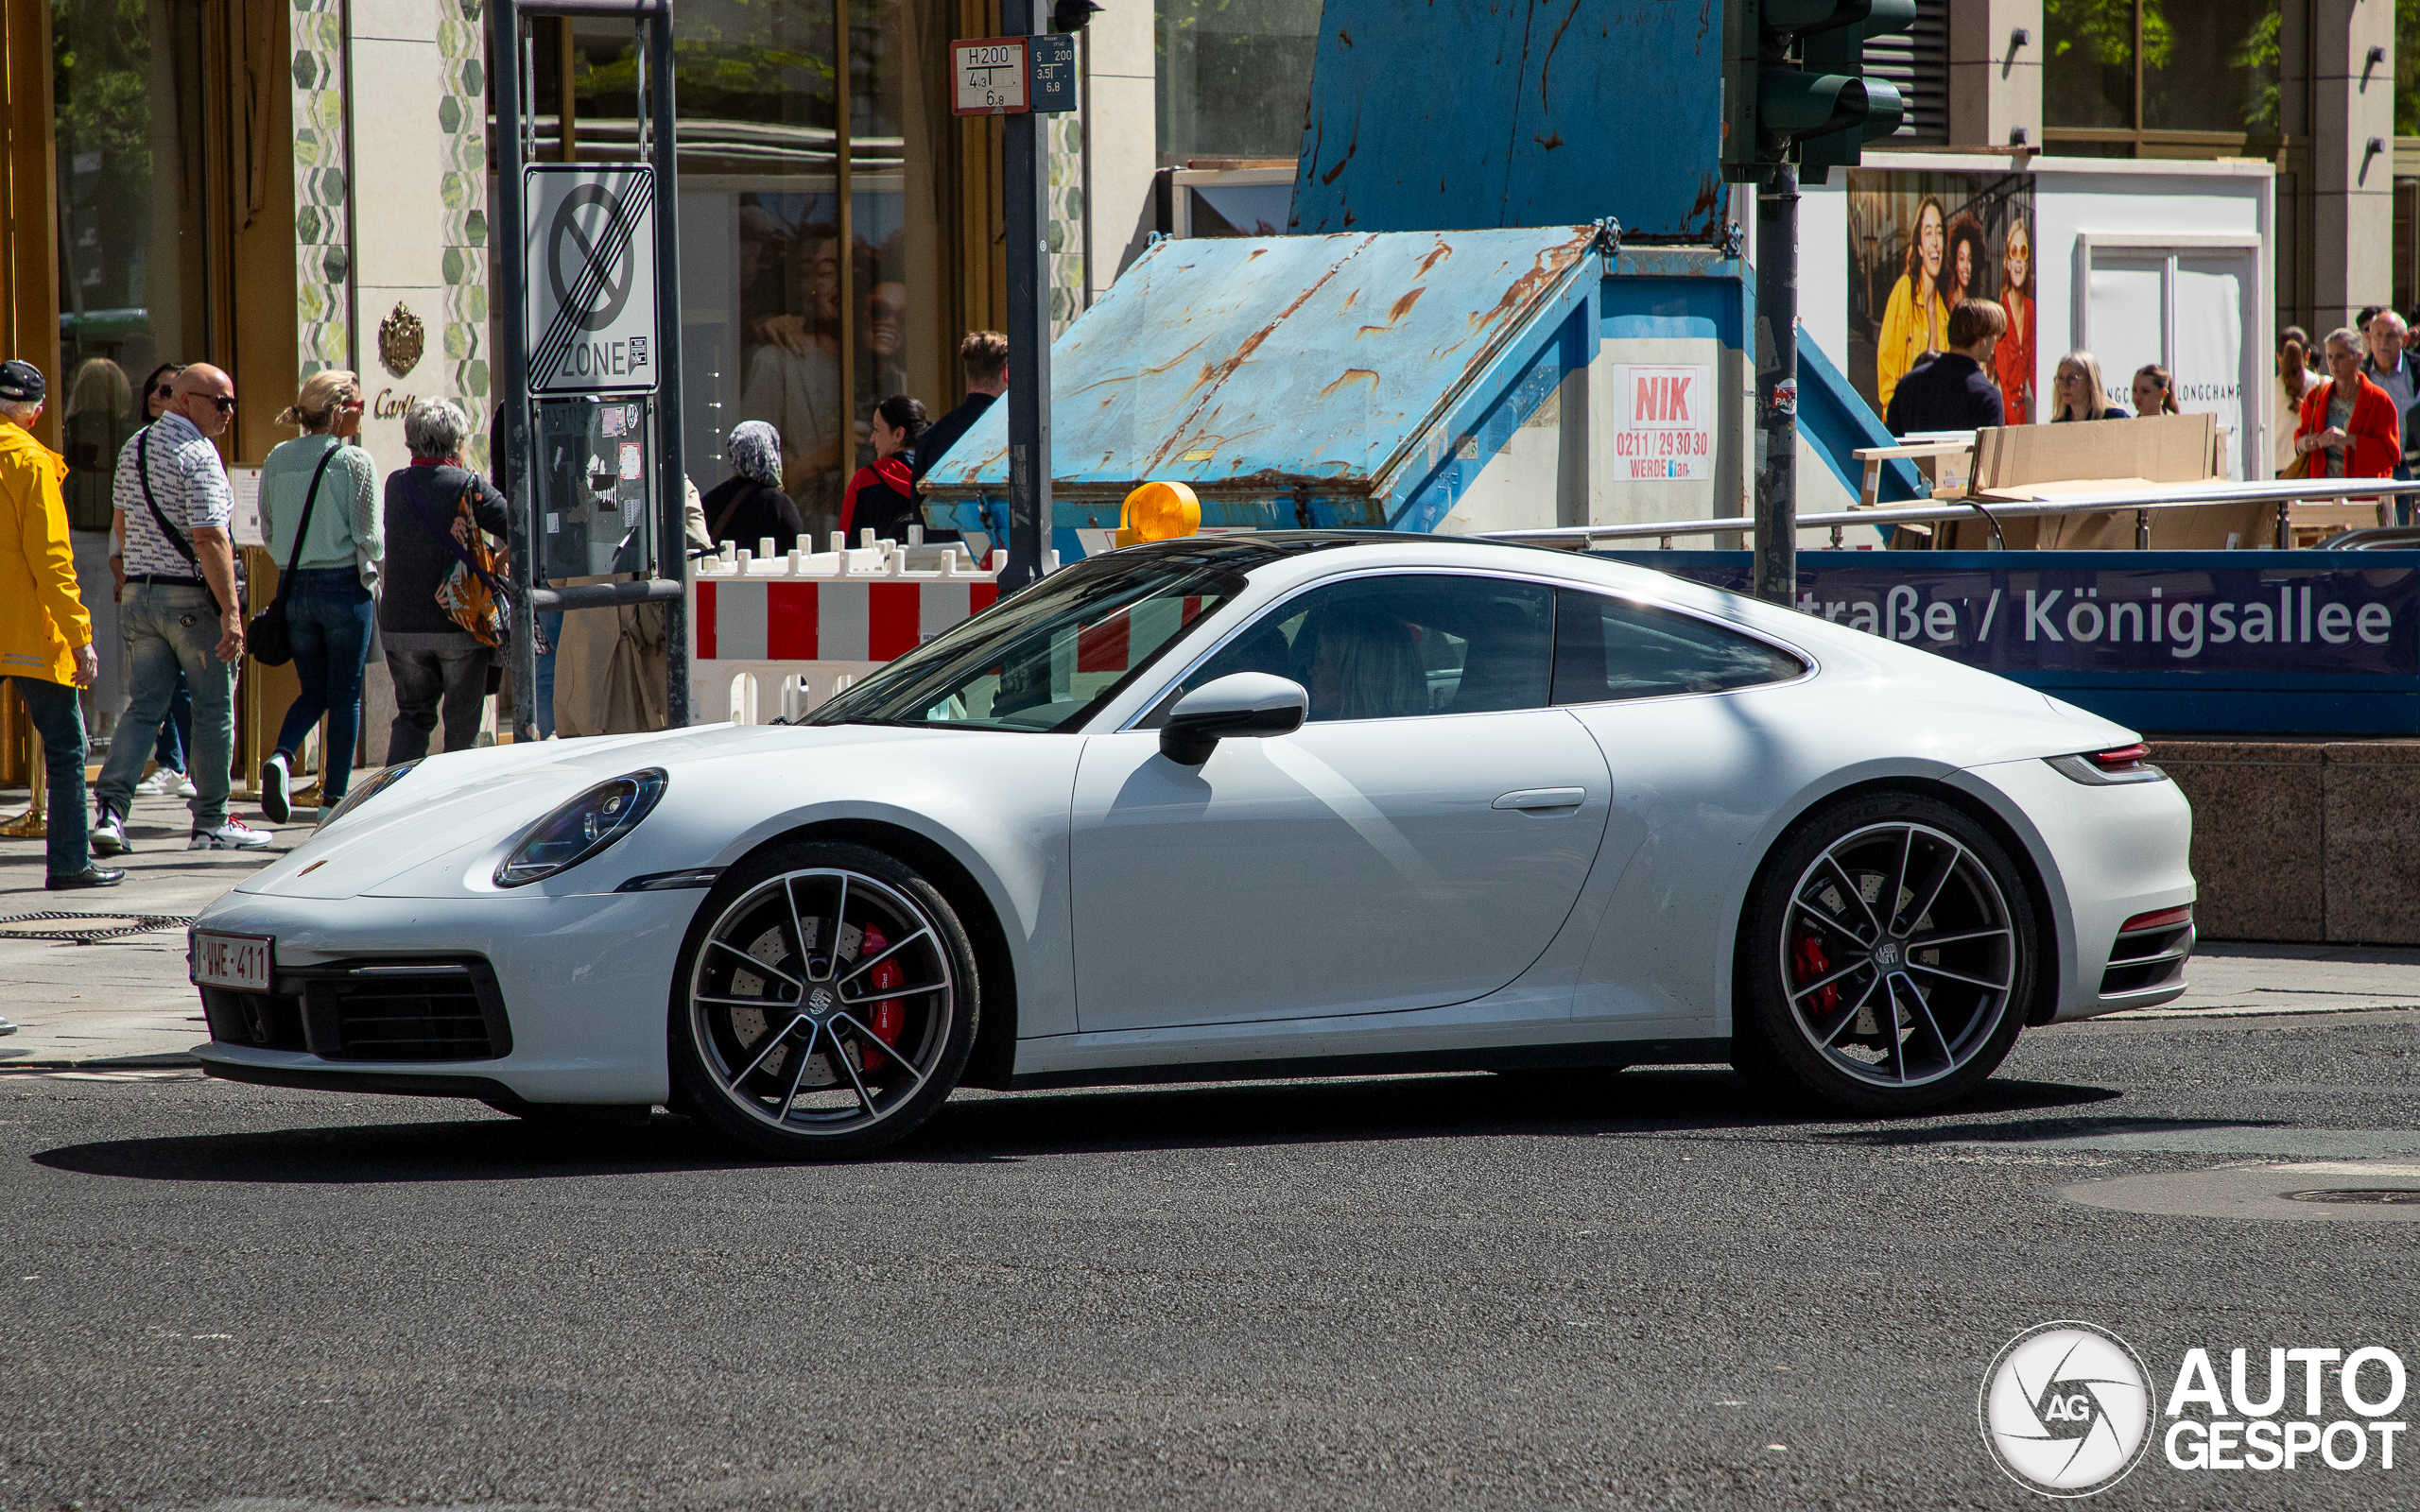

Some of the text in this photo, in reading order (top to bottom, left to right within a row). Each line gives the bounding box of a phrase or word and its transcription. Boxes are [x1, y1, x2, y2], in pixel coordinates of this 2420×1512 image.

[1036, 49, 1072, 62] S 200
[561, 341, 625, 377] ZONE
[1635, 376, 1692, 421] NIK
[1676, 432, 1691, 455] 30
[1693, 432, 1708, 455] 30
[1630, 458, 1666, 478] WERDE
[2026, 586, 2393, 658] Königsallee
